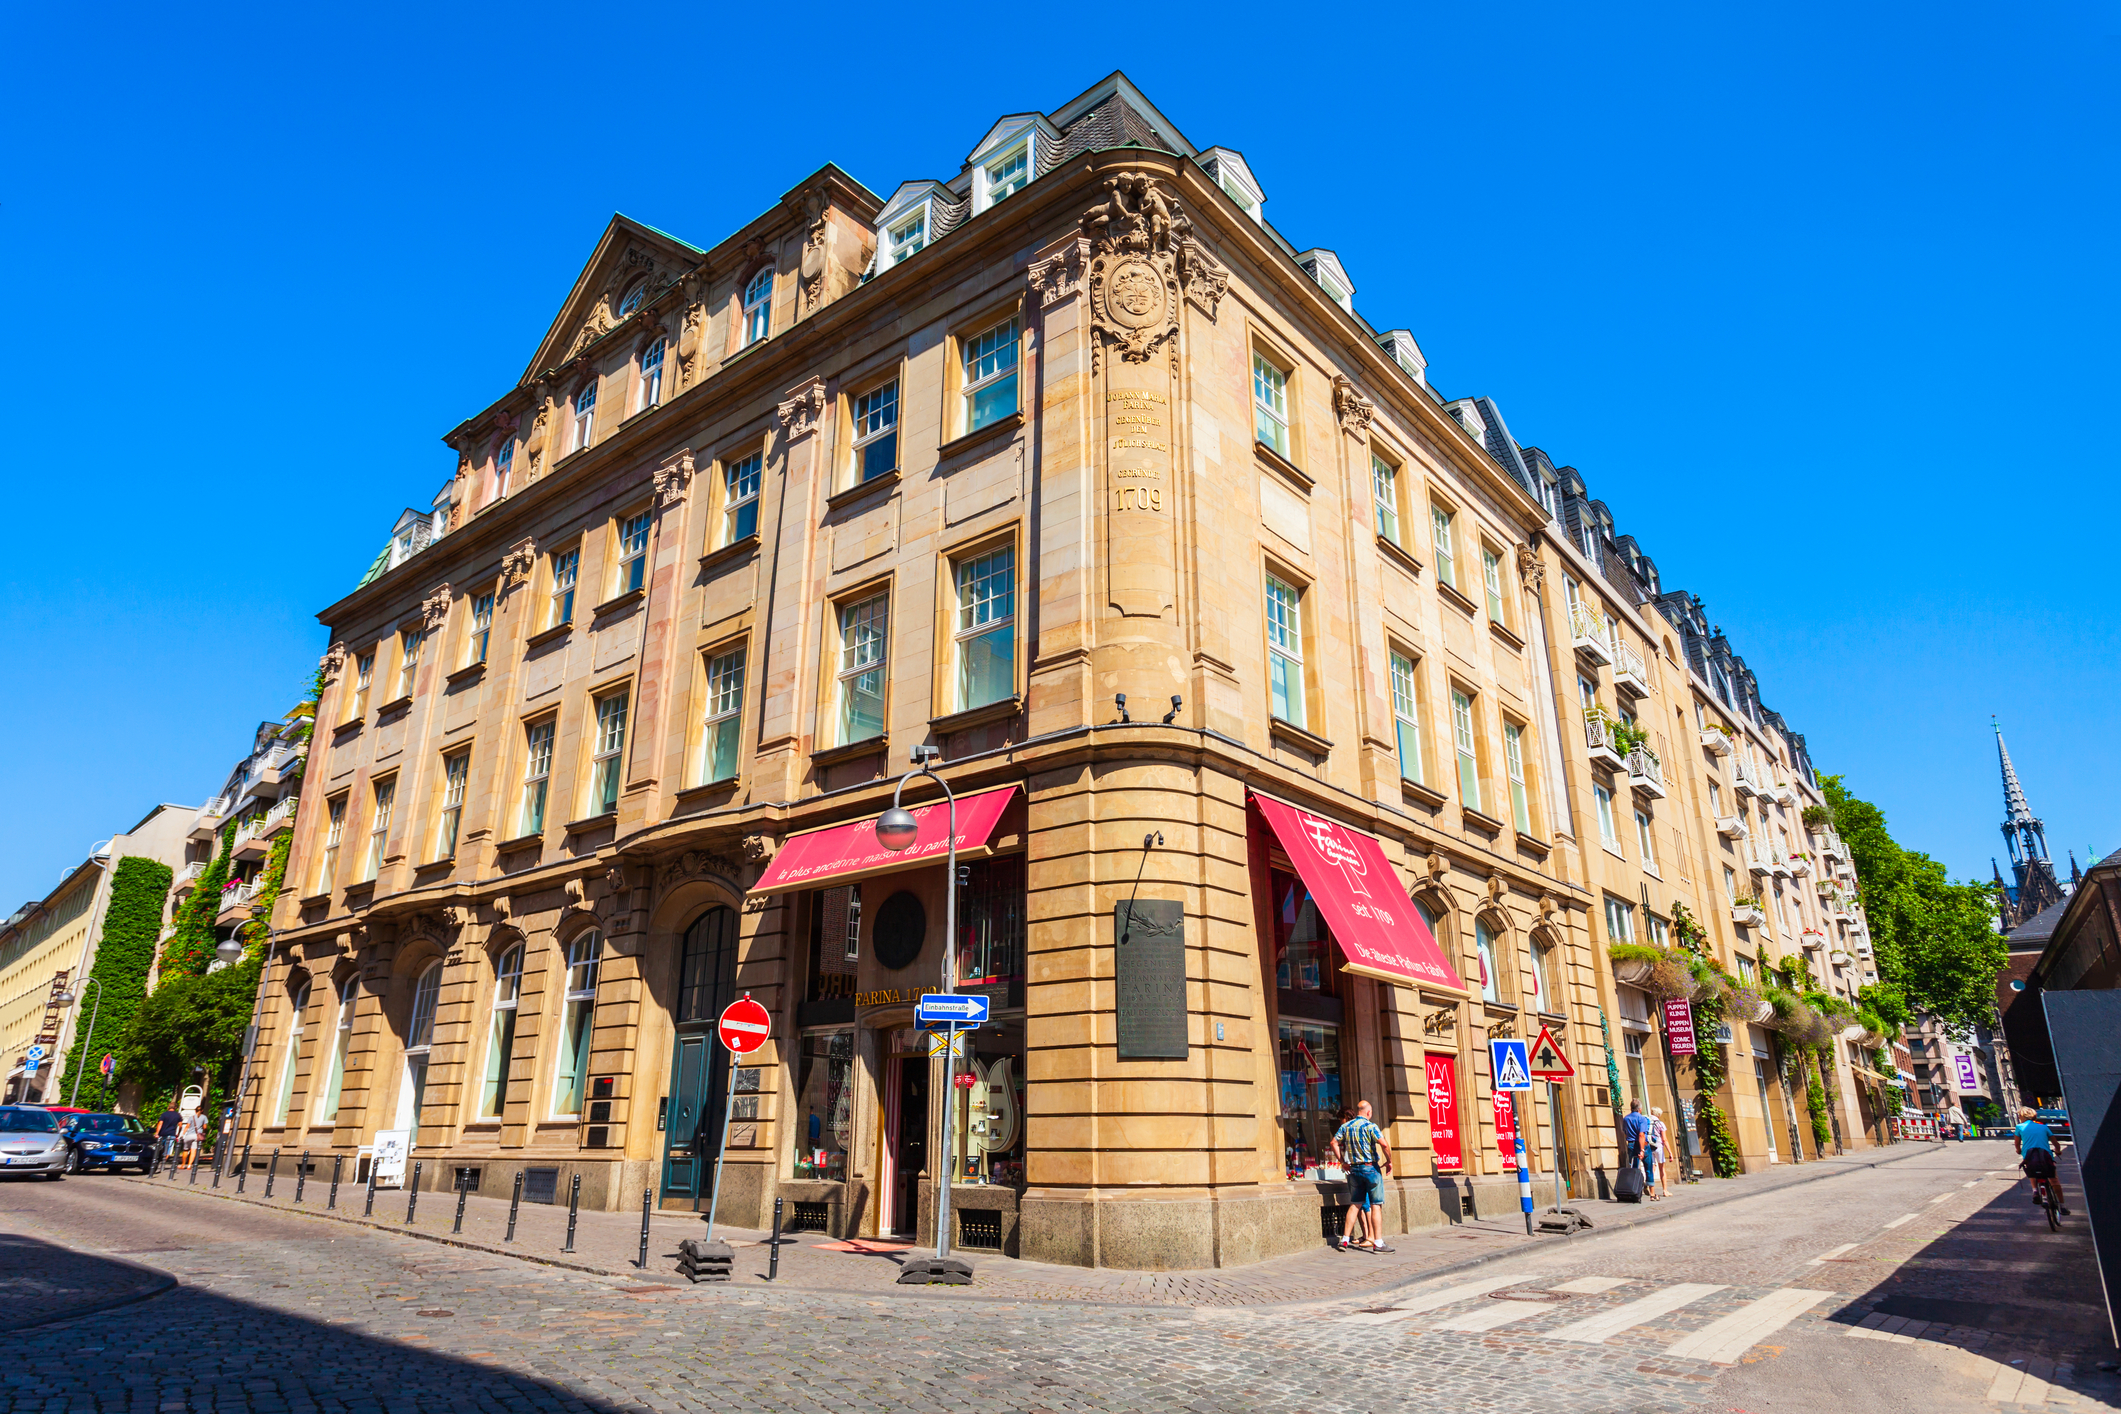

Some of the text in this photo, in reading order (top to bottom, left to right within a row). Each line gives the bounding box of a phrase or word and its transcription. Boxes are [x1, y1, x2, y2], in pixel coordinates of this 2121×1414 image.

[1107, 391, 1166, 406] JOHANN MARIA
[1123, 400, 1154, 411] FARINA
[1116, 414, 1160, 427] GEGENÜBER
[1131, 426, 1148, 434] DEM
[1115, 487, 1162, 512] 1709
[1303, 818, 1356, 857] Farina
[777, 869, 787, 880] la
[786, 866, 812, 880] plus
[812, 857, 860, 874] ancienne
[904, 843, 922, 855] du
[1351, 902, 1394, 926] seit 1709
[1354, 943, 1448, 978] Die älteste Parfum Fabrik
[1121, 983, 1185, 994] FARINA
[855, 989, 900, 1007] FARINA
[27, 1061, 35, 1069] P
[1957, 1062, 1971, 1080] P
[1432, 1129, 1453, 1138] since 1709
[1505, 1132, 1514, 1140] 1709
[1443, 1154, 1459, 1166] Cologne
